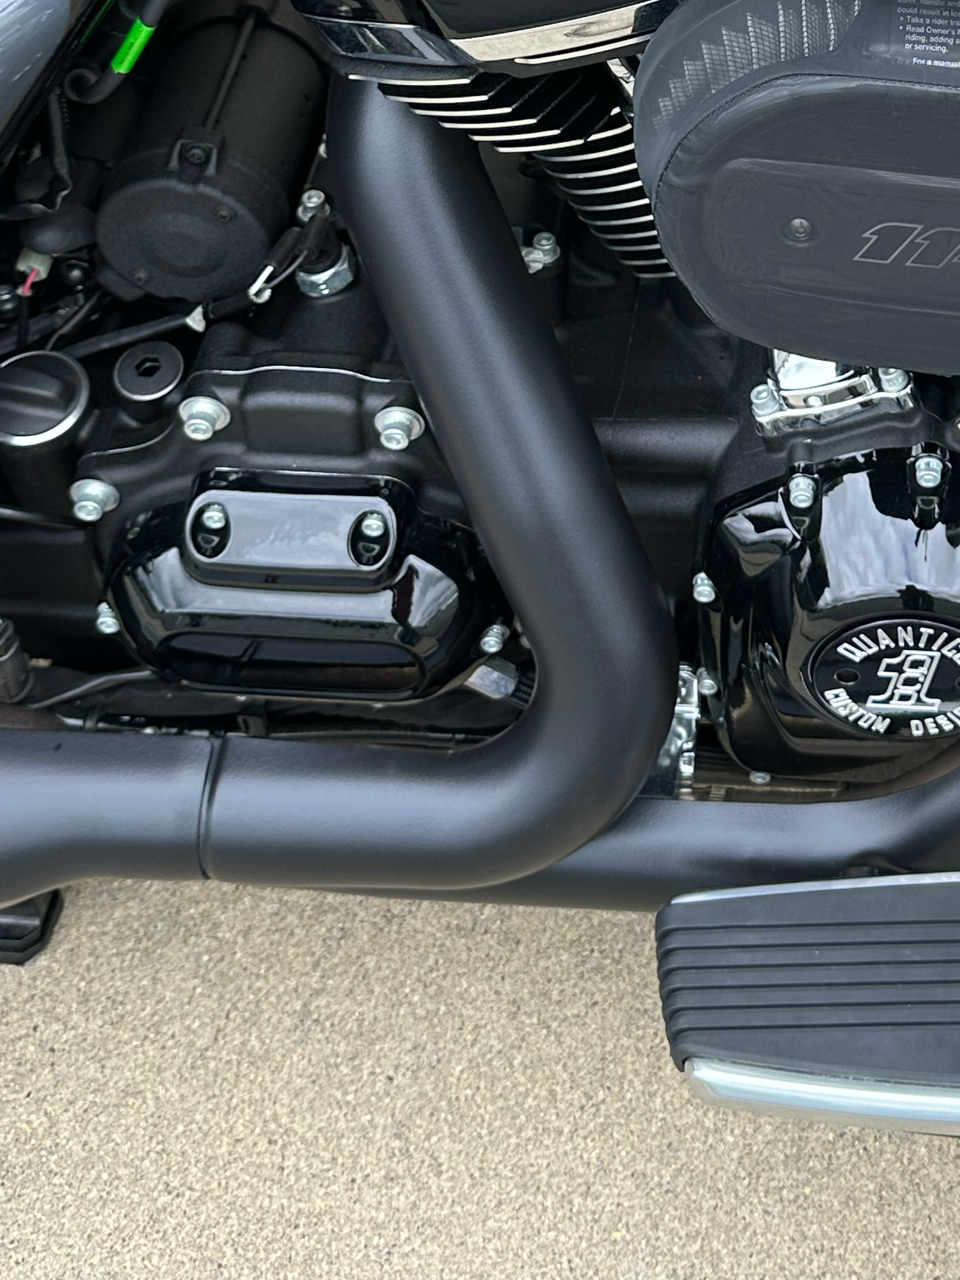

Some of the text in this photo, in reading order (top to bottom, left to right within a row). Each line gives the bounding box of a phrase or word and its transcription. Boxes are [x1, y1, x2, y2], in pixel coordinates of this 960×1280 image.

[897, 6, 918, 14] could
[919, 7, 941, 15] result
[906, 15, 924, 24] Take
[932, 18, 949, 26] rider
[905, 24, 924, 33] Read
[926, 26, 955, 36] Owner's
[905, 34, 928, 43] riding,
[929, 35, 954, 45] adding
[914, 44, 949, 54] servicing.
[912, 57, 925, 65] For
[823, 687, 891, 735] CUSTOM
